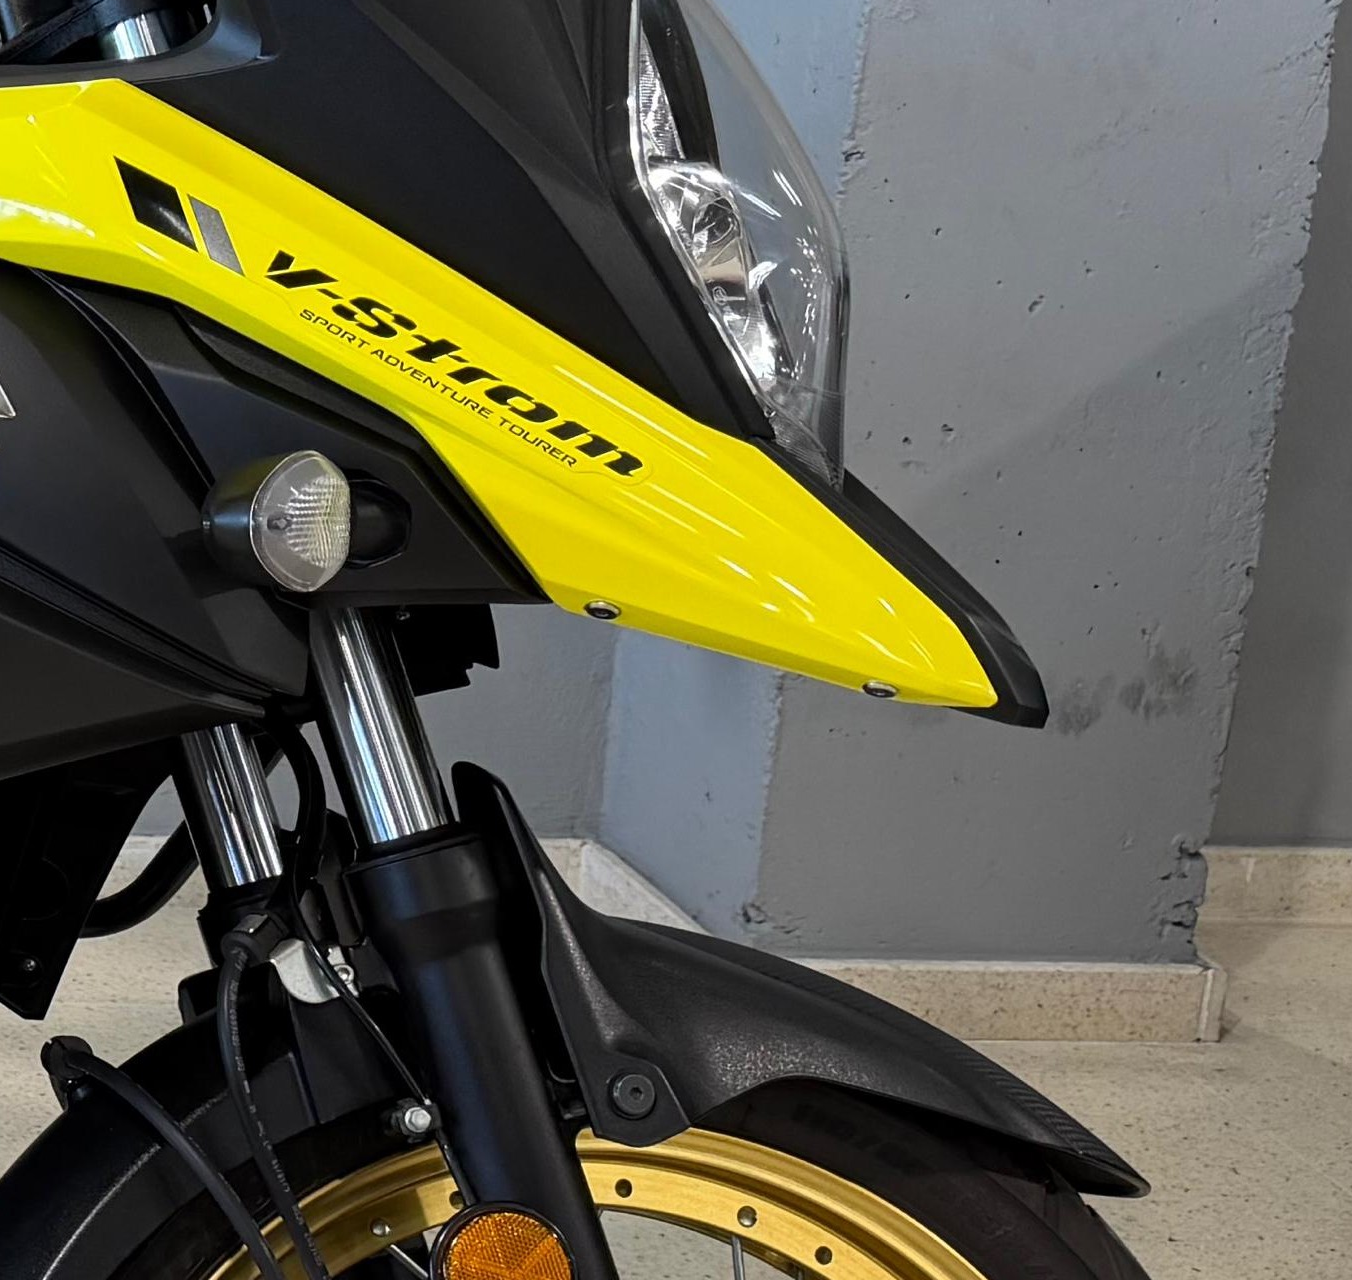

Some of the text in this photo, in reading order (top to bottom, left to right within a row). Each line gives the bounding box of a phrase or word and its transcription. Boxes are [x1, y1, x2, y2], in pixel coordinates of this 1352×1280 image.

[299, 308, 578, 469] SPORT ADVENTURE TOURER
